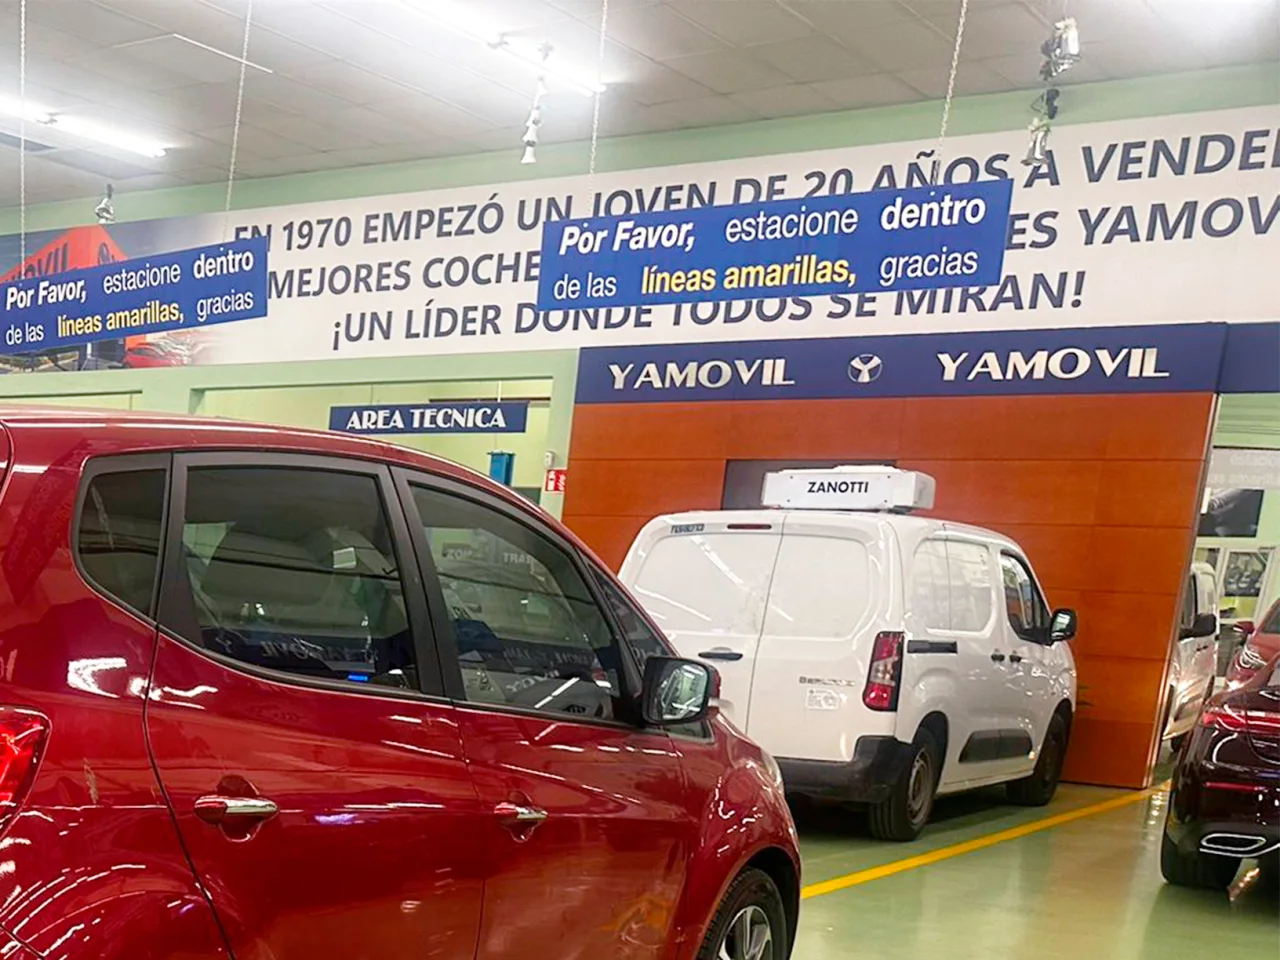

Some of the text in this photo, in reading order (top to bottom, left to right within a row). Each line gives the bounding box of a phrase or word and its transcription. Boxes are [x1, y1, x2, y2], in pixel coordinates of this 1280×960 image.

[282, 216, 352, 251] 1970
[363, 193, 504, 244] EMPEZÓ
[517, 196, 573, 231] UN
[592, 182, 716, 217] JOVEN
[732, 174, 788, 205] DE
[804, 168, 853, 197] 20
[871, 149, 1010, 192] AÑOS
[1023, 150, 1060, 188] A
[559, 195, 986, 255] Por Favor, estacione dentro
[6, 286, 35, 311] Por
[38, 279, 87, 305] Favor,
[103, 263, 181, 294] estacione
[193, 250, 254, 279] dentro
[268, 260, 412, 300] MEJORES
[554, 246, 978, 300] de las líneas amarillas, gracias
[5, 289, 254, 346] de las líneas amarillas, gracias
[333, 311, 392, 350] ¡UN
[405, 300, 502, 339] LÍDER
[514, 303, 653, 334] DONDE
[826, 293, 877, 319] SE
[894, 270, 1086, 316] MIRAN!
[608, 358, 795, 389] YAMOVIL
[937, 348, 1170, 381] YAMOVIL
[346, 408, 506, 430] AREA TECNICA
[807, 481, 869, 493] ZANOTTI
